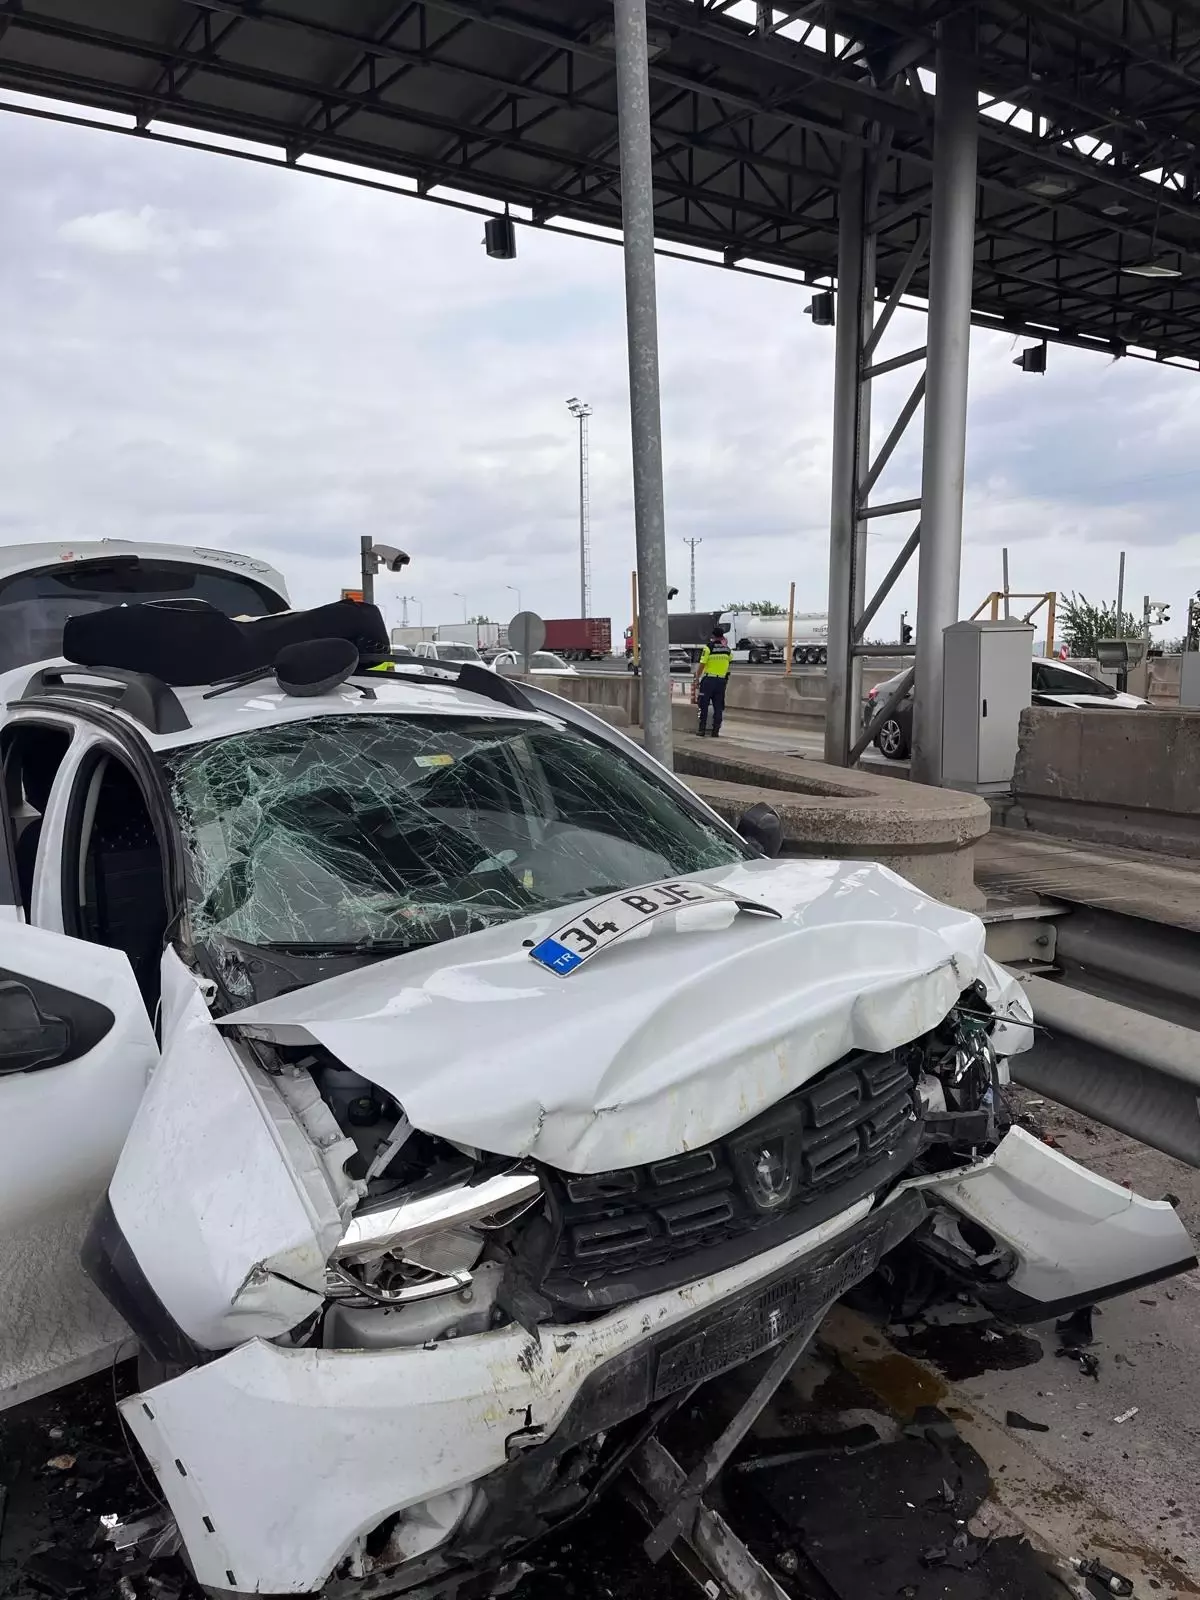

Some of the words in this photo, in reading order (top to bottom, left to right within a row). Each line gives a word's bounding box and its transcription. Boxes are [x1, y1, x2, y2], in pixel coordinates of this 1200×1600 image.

[620, 884, 704, 914] BJE
[560, 917, 619, 953] 34
[553, 952, 574, 967] TR
